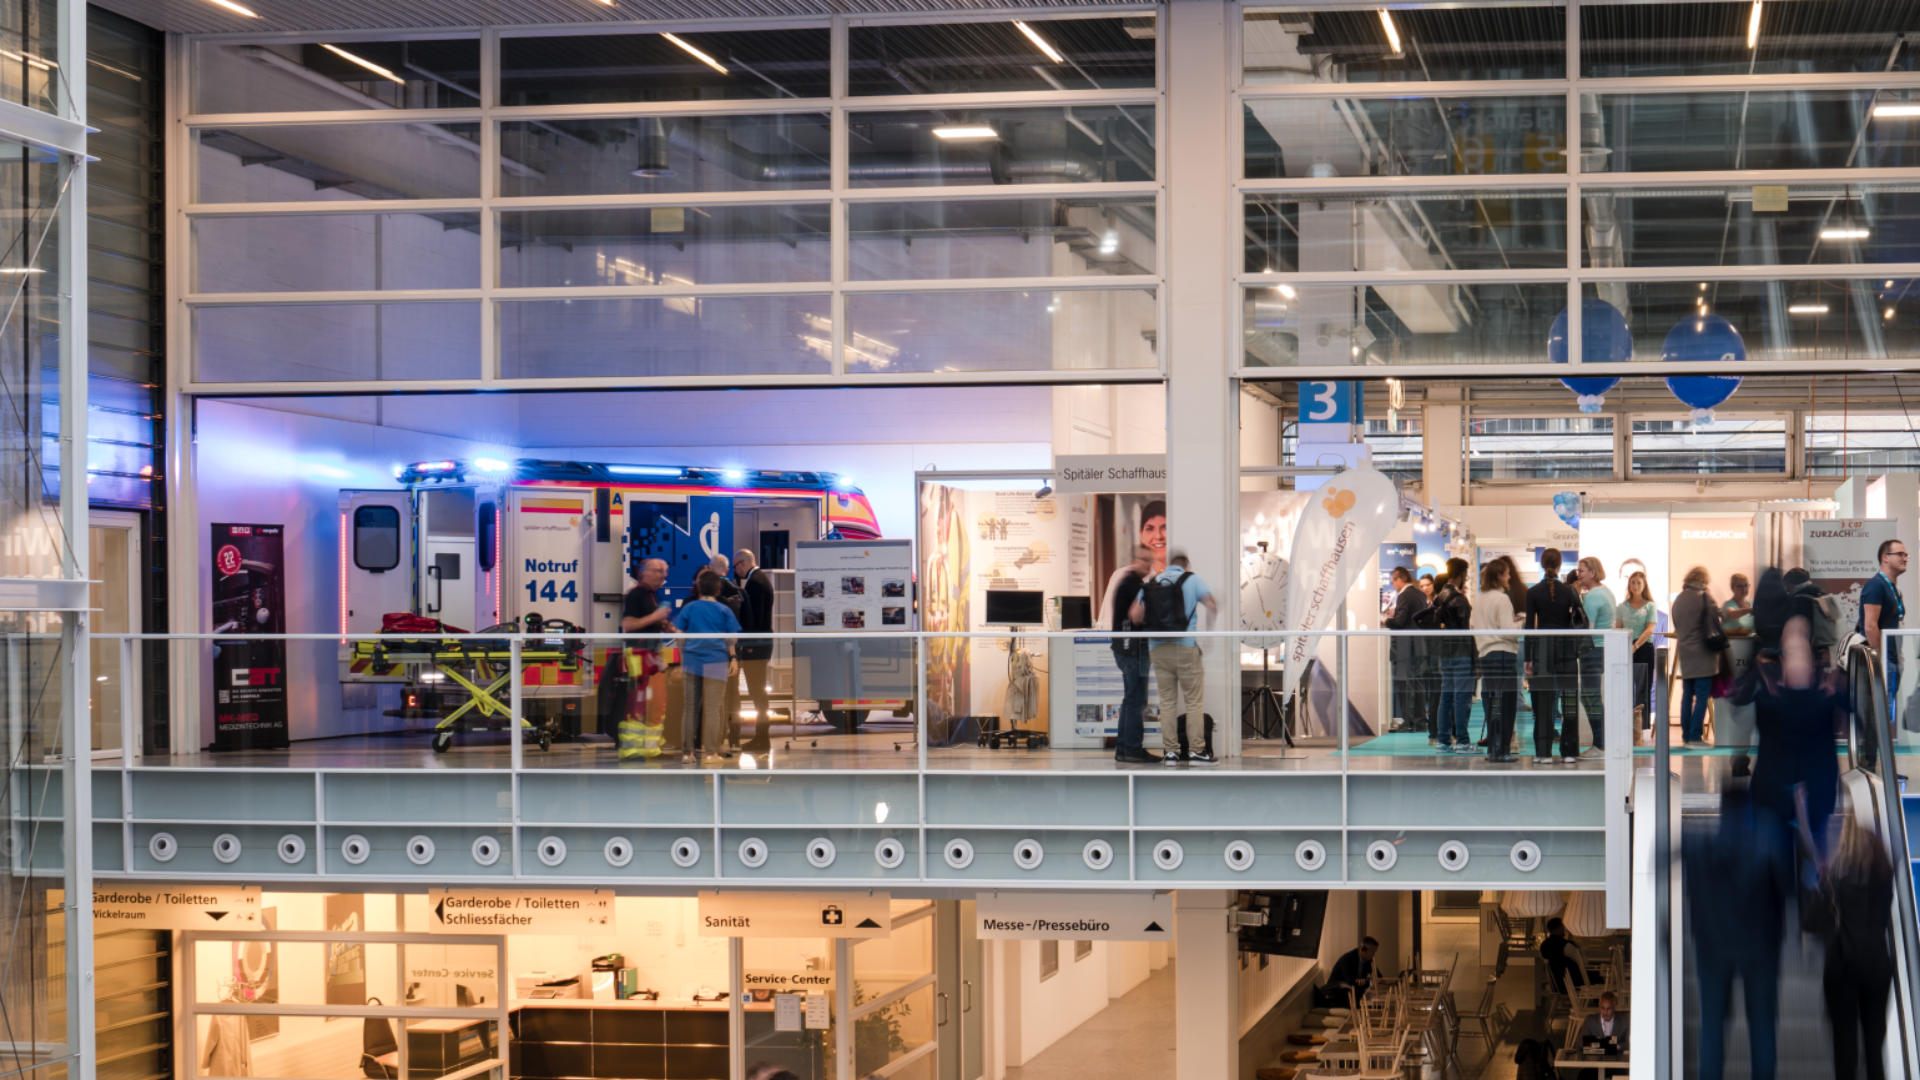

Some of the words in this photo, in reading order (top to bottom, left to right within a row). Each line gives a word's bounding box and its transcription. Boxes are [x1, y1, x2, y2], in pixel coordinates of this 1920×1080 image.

[1309, 380, 1337, 420] 3
[1063, 467, 1104, 481] Spitäler
[1681, 530, 1748, 539] ZURZACHCare
[1810, 530, 1870, 538] ZURZACHCare
[525, 558, 578, 573] Notruf
[1311, 520, 1355, 612] schaffhausen
[525, 580, 578, 602] 144
[219, 713, 259, 723] MK-MED
[219, 723, 272, 731] MEDIZINTECHNIK
[163, 893, 218, 905] Toiletten
[446, 896, 511, 909] Garderobe
[524, 897, 580, 909] Toiletten
[446, 913, 533, 925] Schliessfächer
[705, 916, 750, 928] Sanität
[983, 918, 1110, 932] Messe-/Pressebüro
